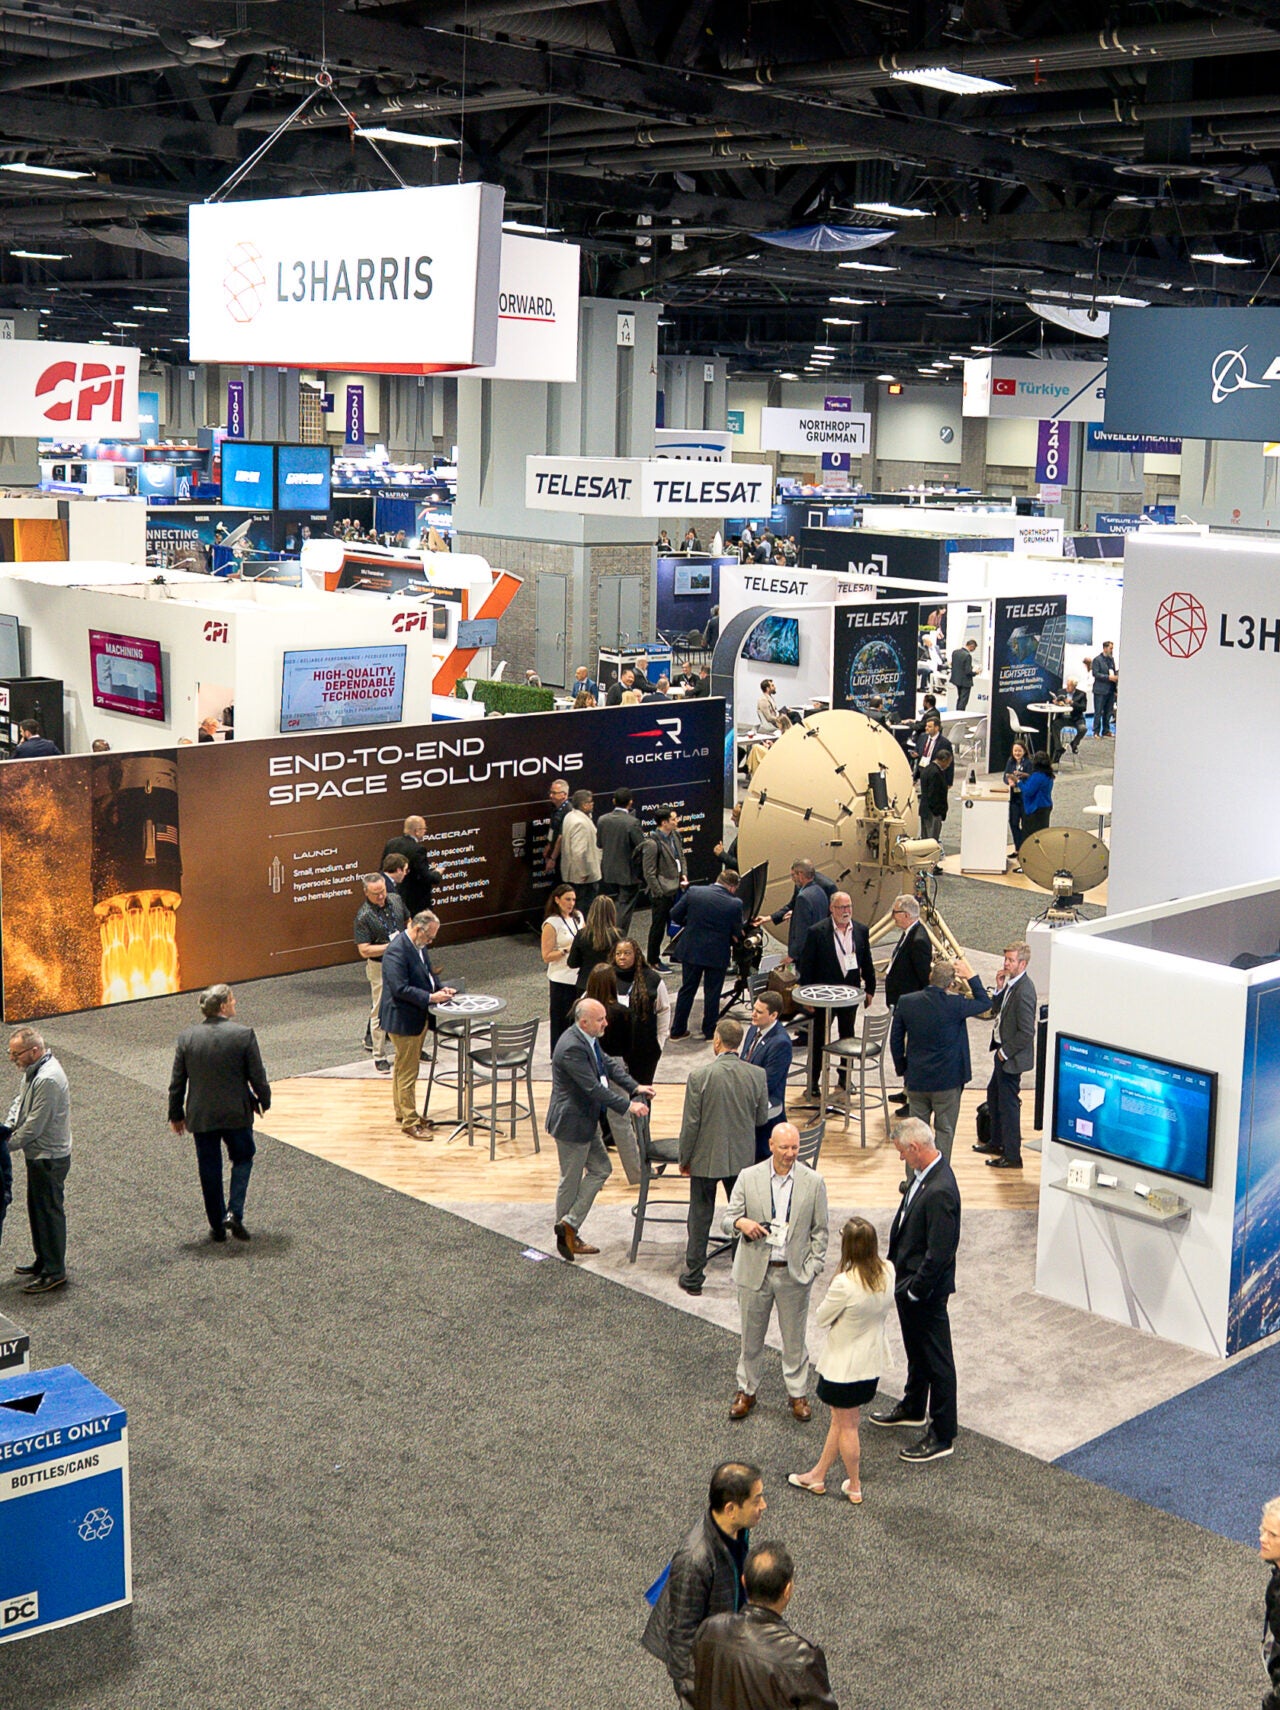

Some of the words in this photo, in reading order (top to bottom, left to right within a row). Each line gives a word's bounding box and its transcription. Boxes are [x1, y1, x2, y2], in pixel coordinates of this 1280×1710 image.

[277, 255, 433, 302] L3HARRIS
[499, 293, 556, 317] ORWARD.
[622, 318, 630, 329] A
[621, 331, 631, 342] 14
[1019, 381, 1070, 397] Türkiye
[232, 391, 240, 435] 1900
[351, 395, 359, 441] 2000
[799, 419, 851, 431] NORTHROP
[806, 431, 857, 443] GRUMMAN
[1045, 420, 1060, 480] 2400
[535, 473, 632, 500] TELESAT
[653, 481, 762, 503] TELESAT
[146, 529, 199, 540] NNECTING
[155, 540, 197, 550] FUTURE
[744, 576, 808, 596] TELESAT
[837, 582, 873, 594] TELESAT
[1005, 602, 1058, 619] TELESAT
[846, 610, 909, 628] TELESAT
[105, 643, 144, 660] MACHINING
[313, 666, 396, 681] HIGH-QUALITY,
[852, 672, 900, 687] LIGHTSPEED
[325, 677, 396, 691] DEPENDABLE
[322, 687, 395, 702] TECHNOLOGY
[269, 737, 485, 776] END-TO-END
[268, 774, 388, 806] SPACE
[400, 752, 583, 791] SOLUTIONS
[642, 800, 685, 812] PAYADS
[422, 828, 481, 841] PACECRAFT
[293, 848, 338, 860] LAUNCH
[427, 849, 441, 858] able
[440, 844, 475, 857] spacecraft
[293, 868, 314, 878] Small,
[314, 864, 344, 874] medium,
[345, 861, 358, 869] and
[442, 870, 468, 880] security,
[293, 878, 331, 891] hypersonic
[332, 874, 355, 884] launch
[355, 873, 369, 881] fro
[442, 883, 455, 892] and
[456, 879, 490, 890] exploration
[293, 895, 307, 903] two
[308, 888, 353, 901] hemispheres.
[436, 897, 449, 905] and
[460, 890, 485, 902] beyond.
[0, 1341, 18, 1356] LY
[0, 1431, 61, 1460] ECYCLE
[67, 1417, 111, 1442] ONLY
[11, 1454, 100, 1489] BOTTLES/CANS
